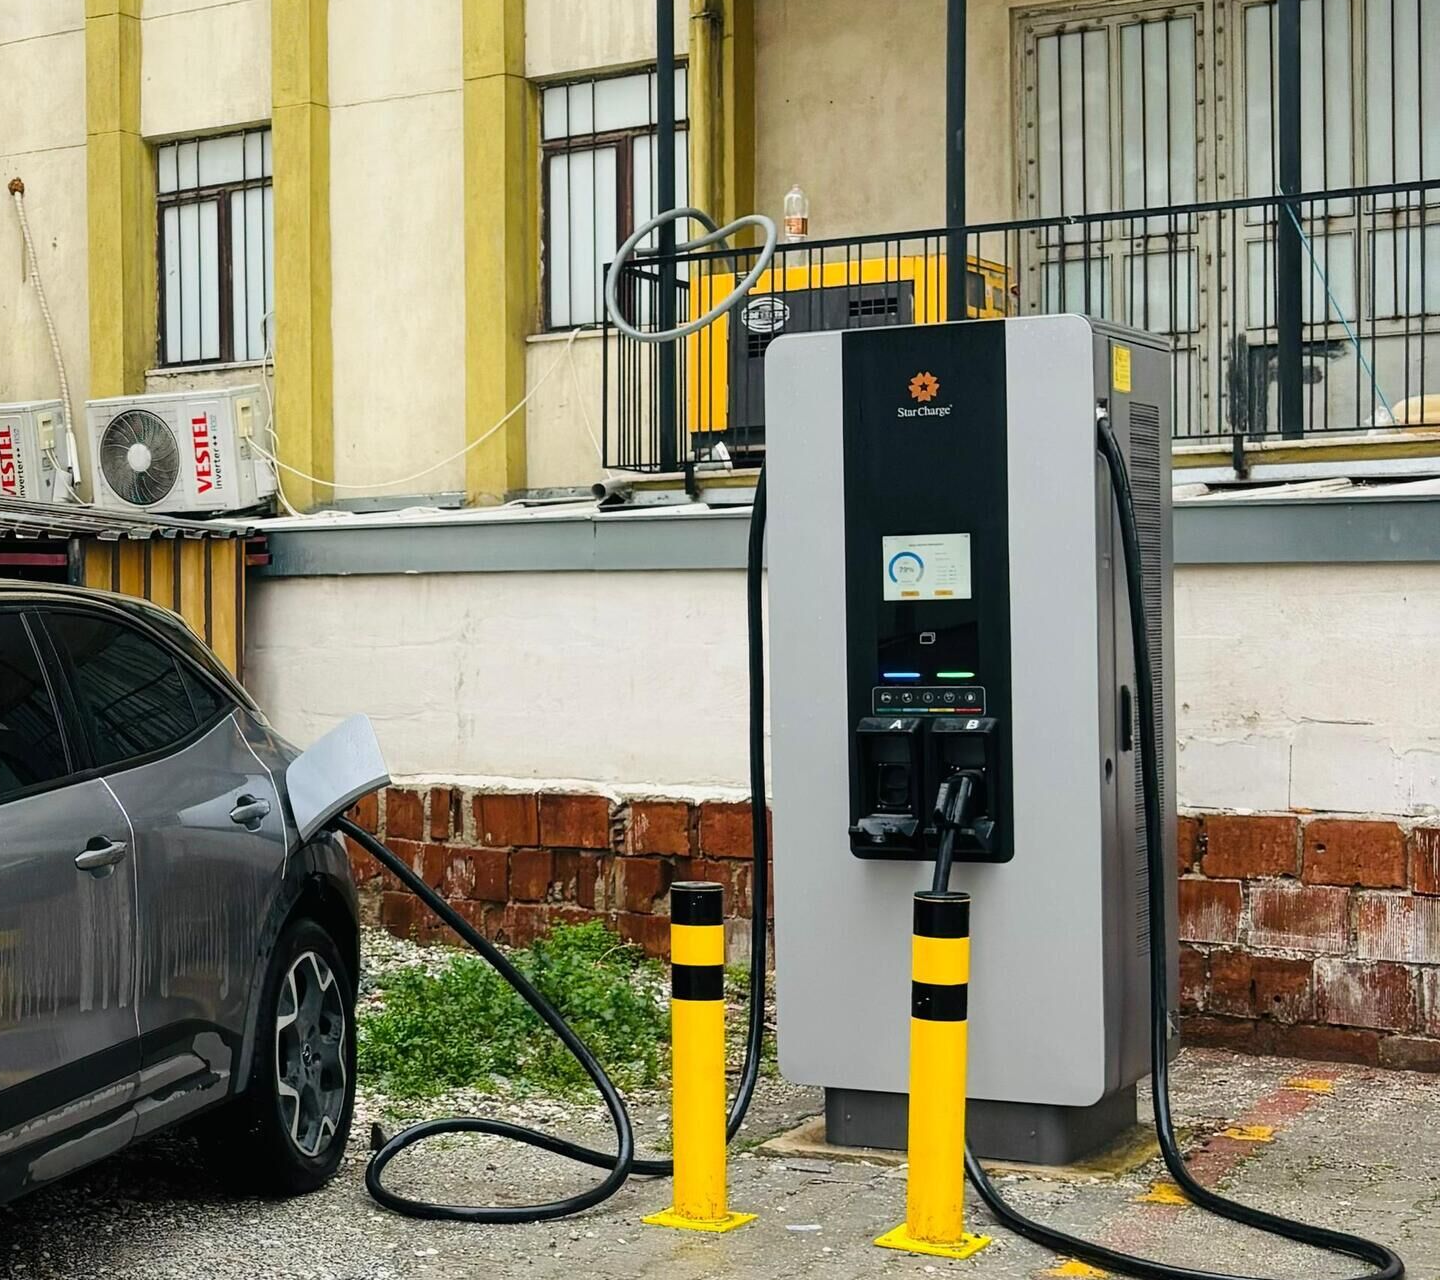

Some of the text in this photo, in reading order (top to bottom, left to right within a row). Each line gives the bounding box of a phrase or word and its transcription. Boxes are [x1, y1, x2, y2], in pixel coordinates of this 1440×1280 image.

[191, 411, 213, 495] VESTEL
[214, 447, 223, 490] inverter
[17, 460, 26, 498] nverter
[889, 719, 902, 729] A
[966, 719, 979, 729] B
